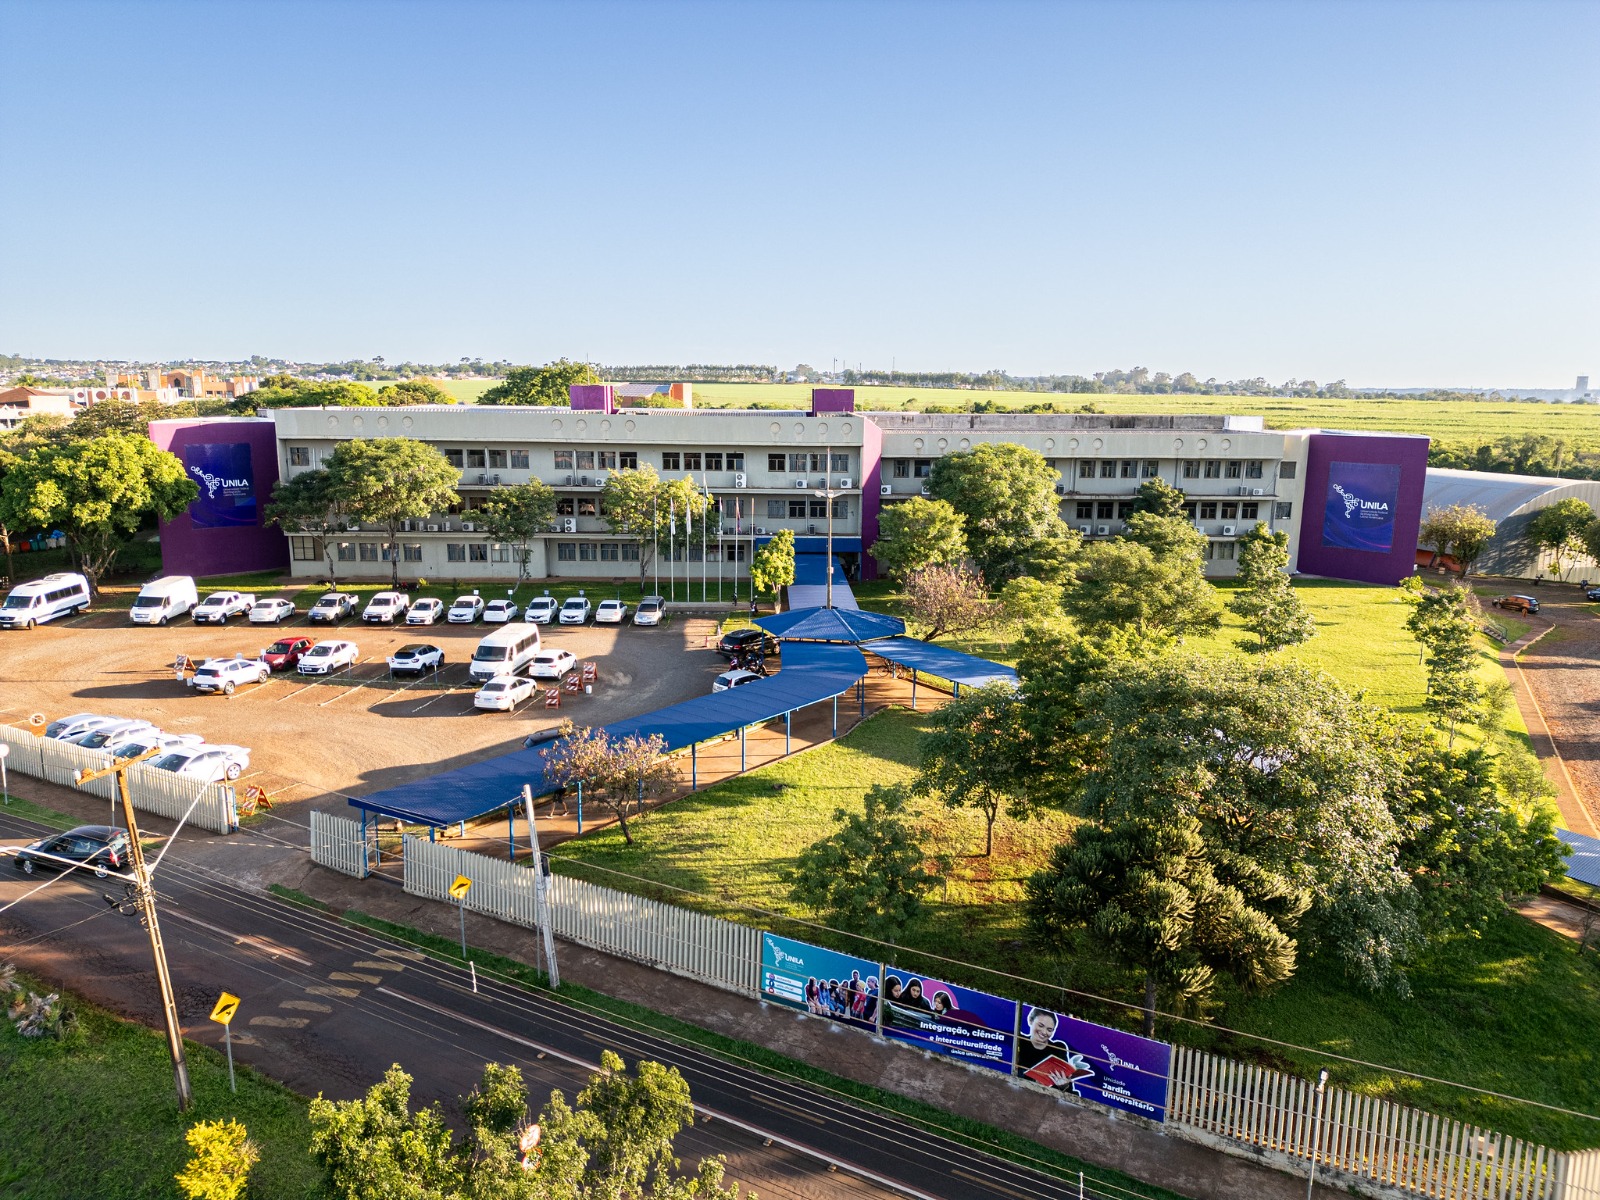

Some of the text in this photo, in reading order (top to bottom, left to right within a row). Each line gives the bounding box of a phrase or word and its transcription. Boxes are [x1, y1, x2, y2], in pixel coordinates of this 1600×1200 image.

[221, 478, 249, 487] UNILA
[1360, 499, 1388, 510] UNILA
[784, 951, 804, 965] UNILA
[920, 1021, 1005, 1041] Integração, ciência
[935, 1035, 1002, 1052] interculturalidade
[1120, 1059, 1140, 1070] UNILA
[1103, 1075, 1126, 1086] Unidade
[1102, 1082, 1131, 1096] Jardim
[1102, 1090, 1155, 1112] Universitário
